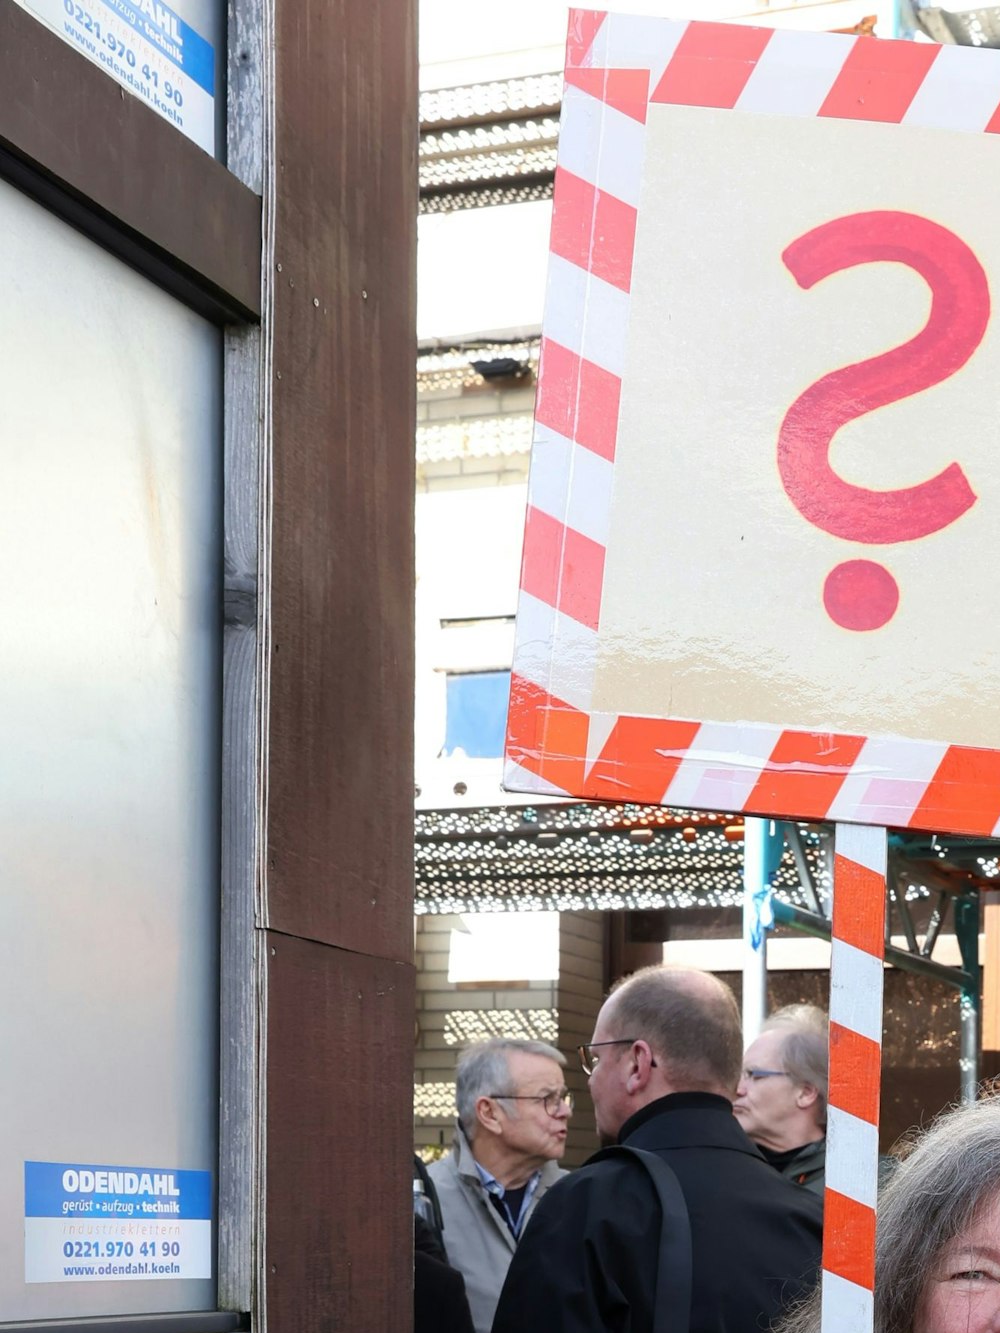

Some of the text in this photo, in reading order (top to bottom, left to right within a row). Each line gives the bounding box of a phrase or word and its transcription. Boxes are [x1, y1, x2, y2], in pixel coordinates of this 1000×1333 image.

[64, 0, 183, 108] 0221.970 41 90
[144, 22, 184, 65] technik
[64, 20, 183, 127] www.odendahl.koeln
[62, 1169, 180, 1196] ODENDAHL
[62, 1199, 180, 1215] gerüst aufzug technik
[63, 1241, 181, 1258] 0221.970 41 90
[63, 1262, 181, 1276] www.odendahl.koeln
